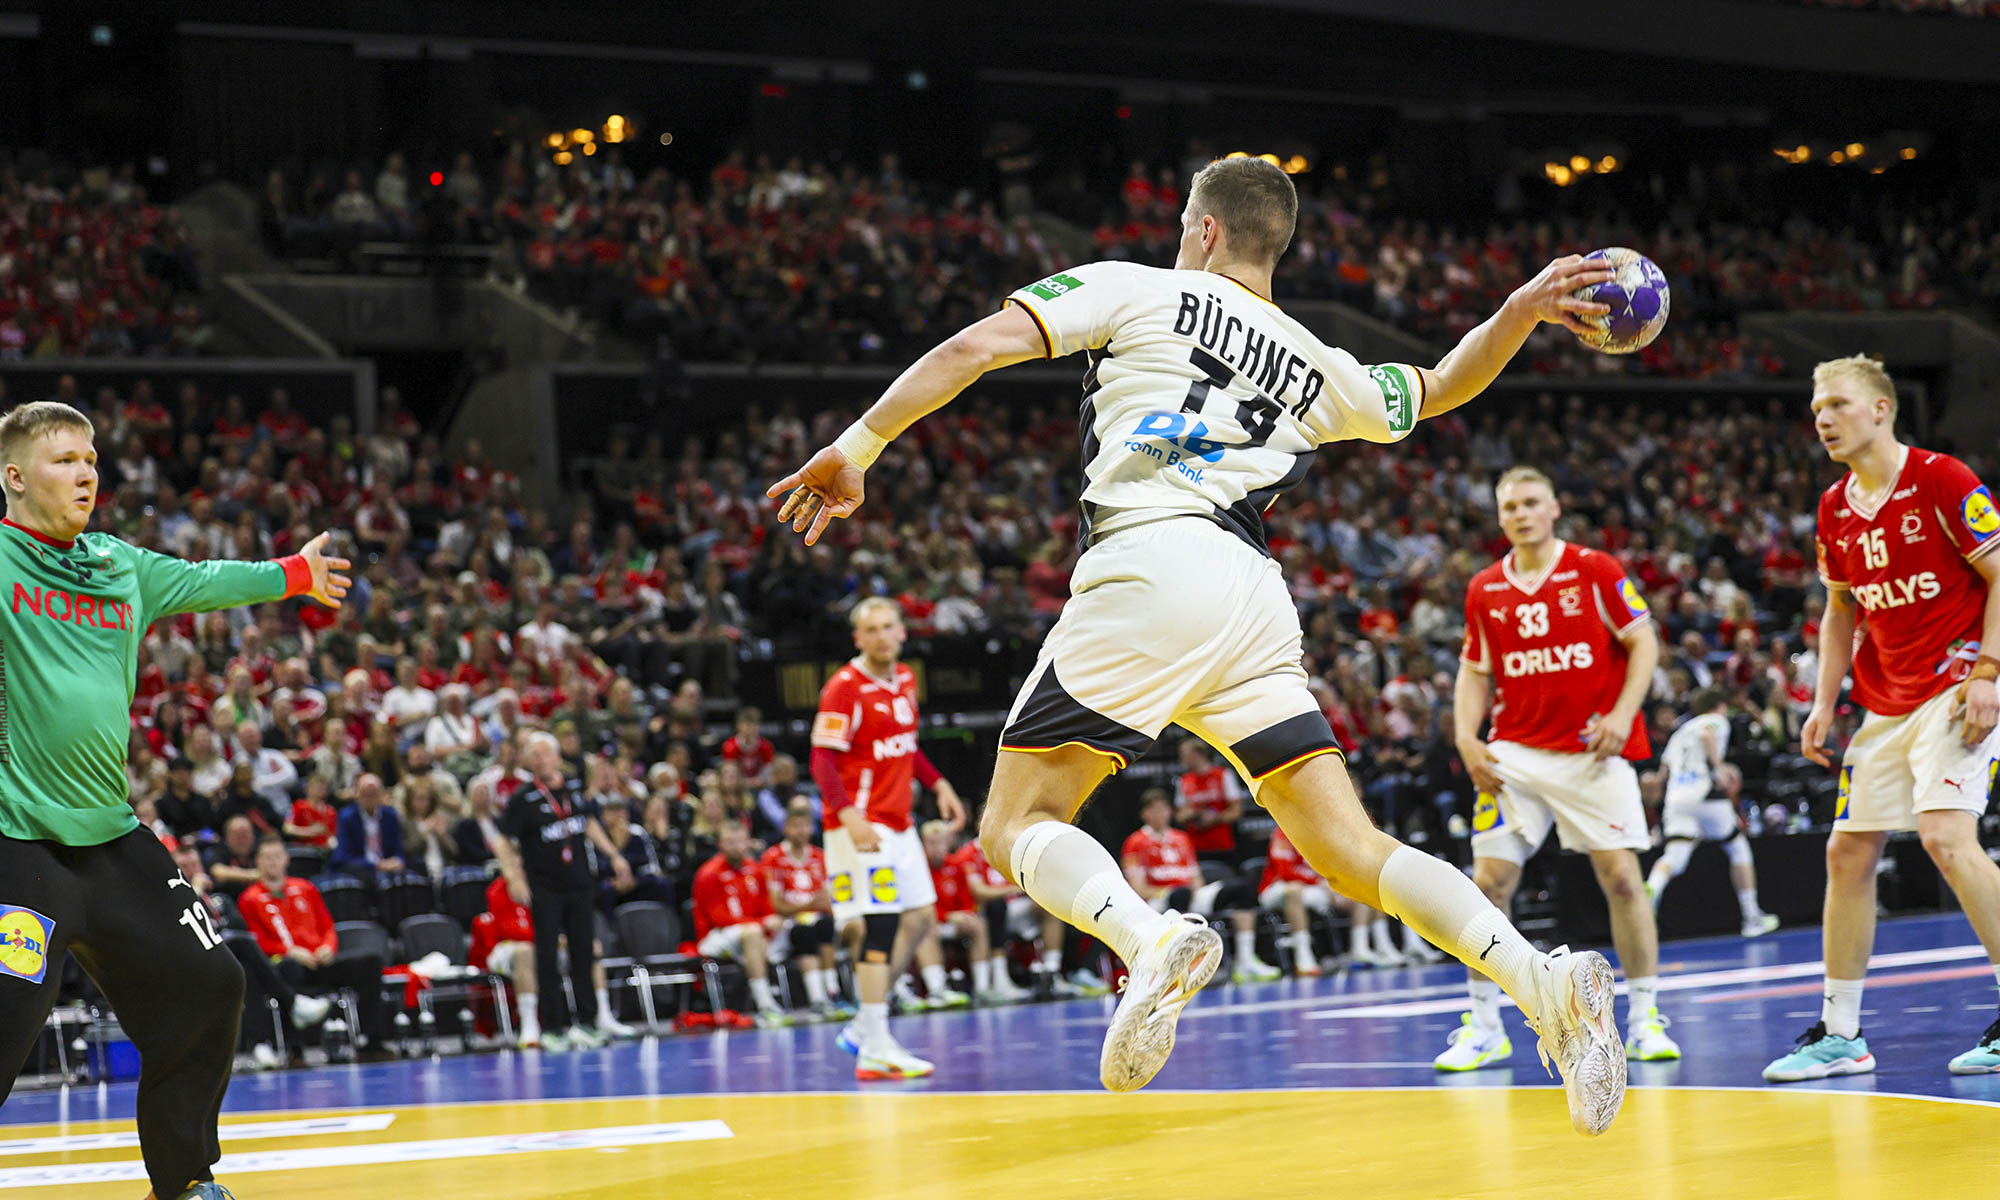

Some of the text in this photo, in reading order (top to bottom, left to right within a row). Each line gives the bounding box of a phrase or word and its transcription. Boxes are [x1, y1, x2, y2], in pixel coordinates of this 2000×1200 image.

[1173, 291, 1325, 423] BÜCHNER
[1166, 449, 1204, 486] Bank
[1856, 527, 1890, 571] 15
[1851, 571, 1942, 612] ORLYS
[1514, 601, 1550, 639] 33
[1502, 641, 1595, 678] ORLYS
[178, 900, 224, 951] 12
